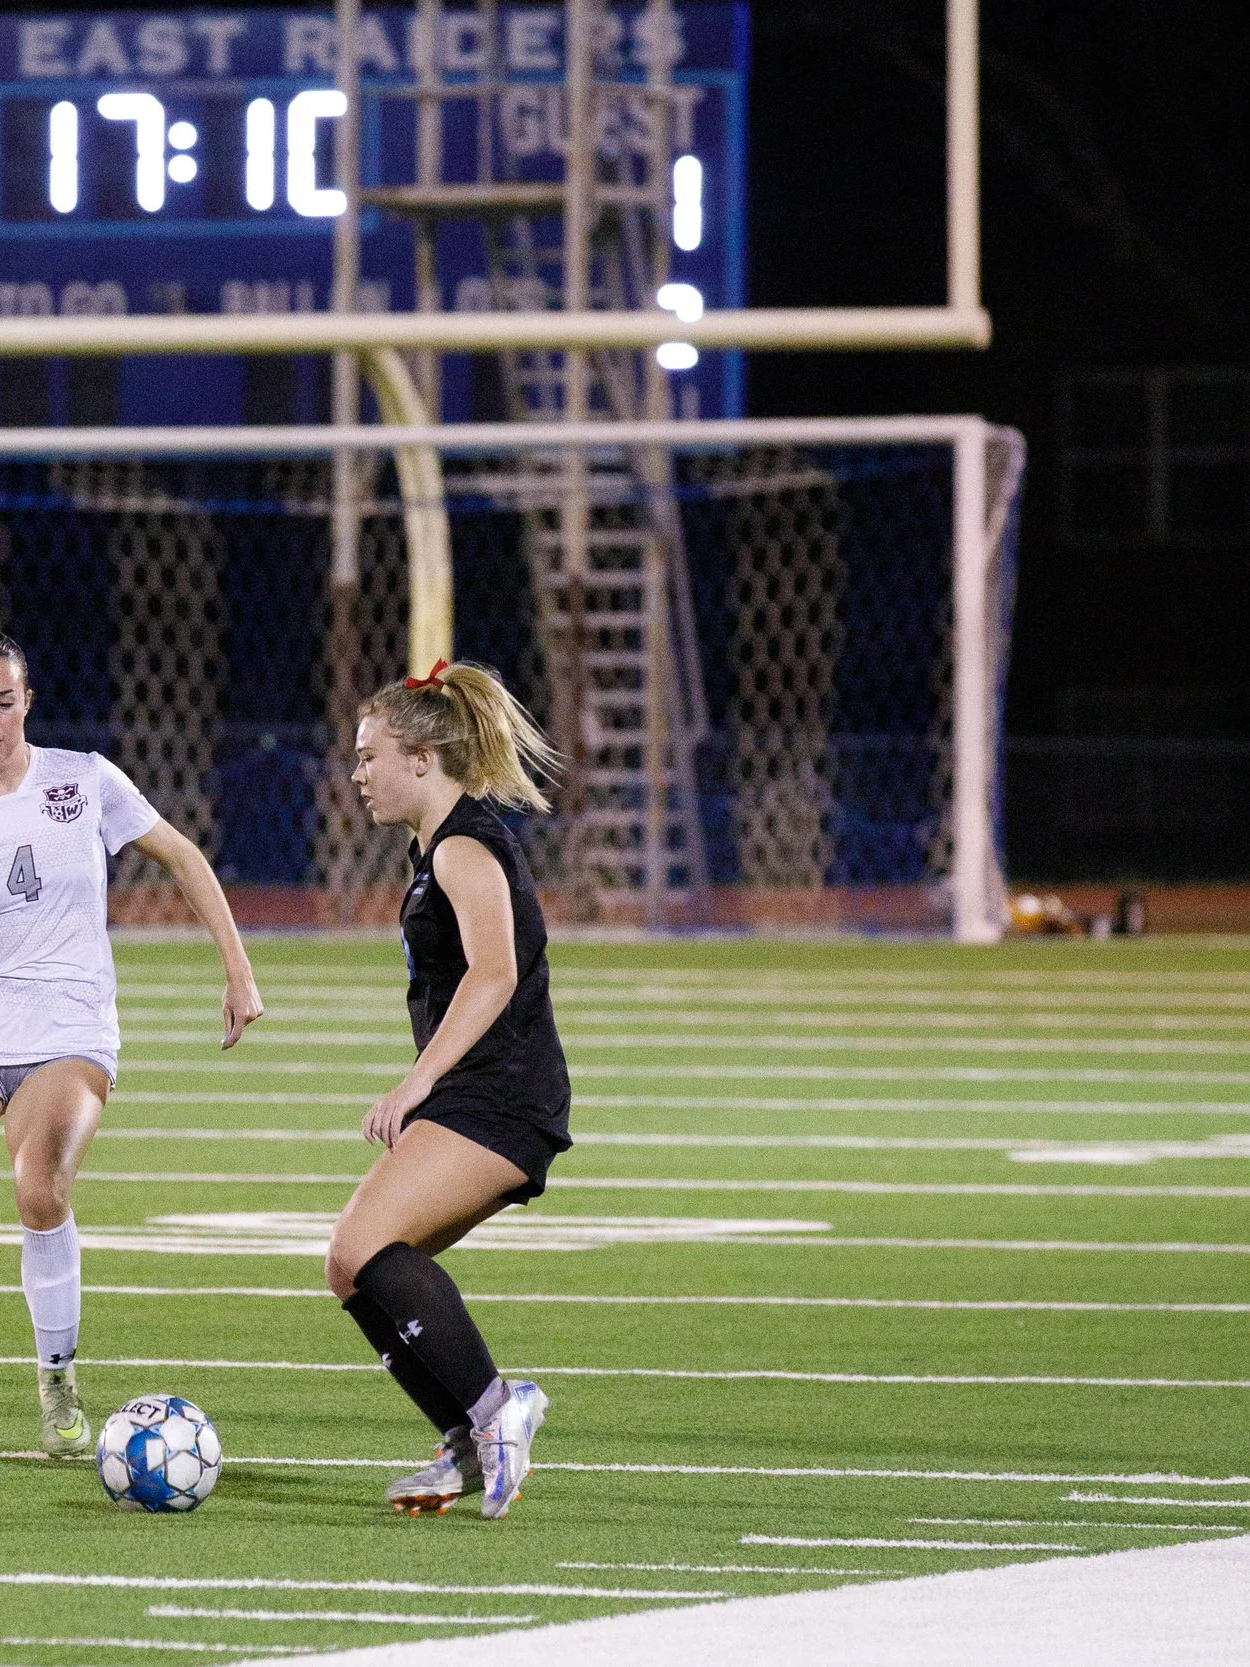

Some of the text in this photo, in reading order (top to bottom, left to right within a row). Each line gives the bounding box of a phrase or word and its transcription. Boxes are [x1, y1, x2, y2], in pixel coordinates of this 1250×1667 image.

[18, 16, 243, 78] EAST
[6, 844, 42, 903] 4
[114, 1402, 162, 1420] LECT
